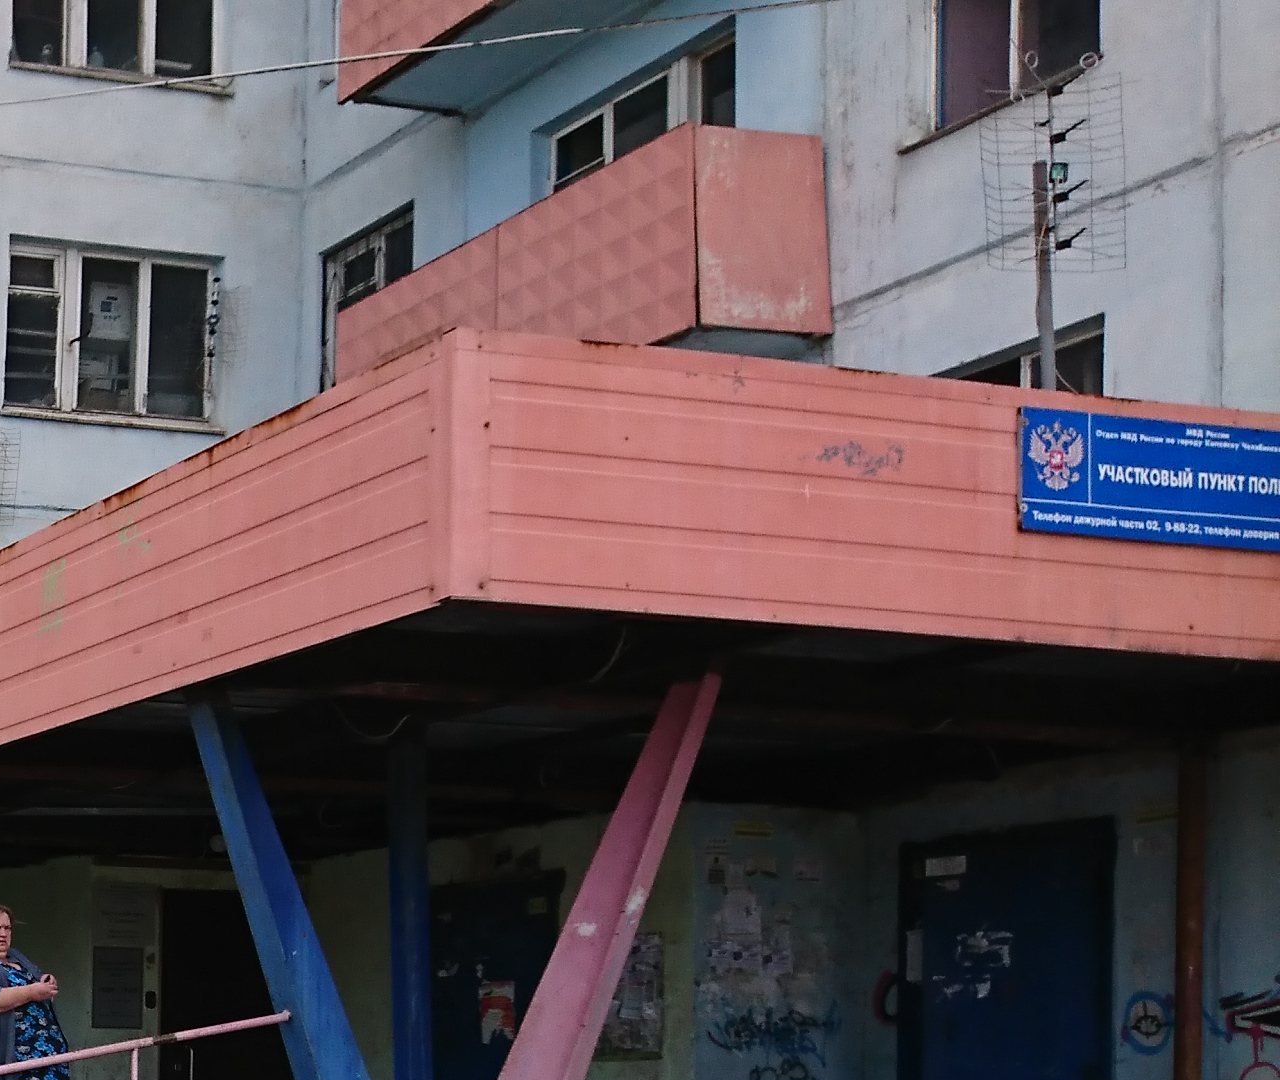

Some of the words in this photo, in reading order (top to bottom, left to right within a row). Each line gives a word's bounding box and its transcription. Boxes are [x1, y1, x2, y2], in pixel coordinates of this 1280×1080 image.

[1097, 463, 1193, 488] УЧАСТКОВЫЙ
[1198, 471, 1246, 492] ПУНКТ
[1248, 476, 1280, 496] ПОЛ
[1032, 510, 1072, 524] Телефон
[1073, 515, 1117, 527] дежурной
[1119, 519, 1144, 530] части
[1203, 525, 1241, 538] телефон
